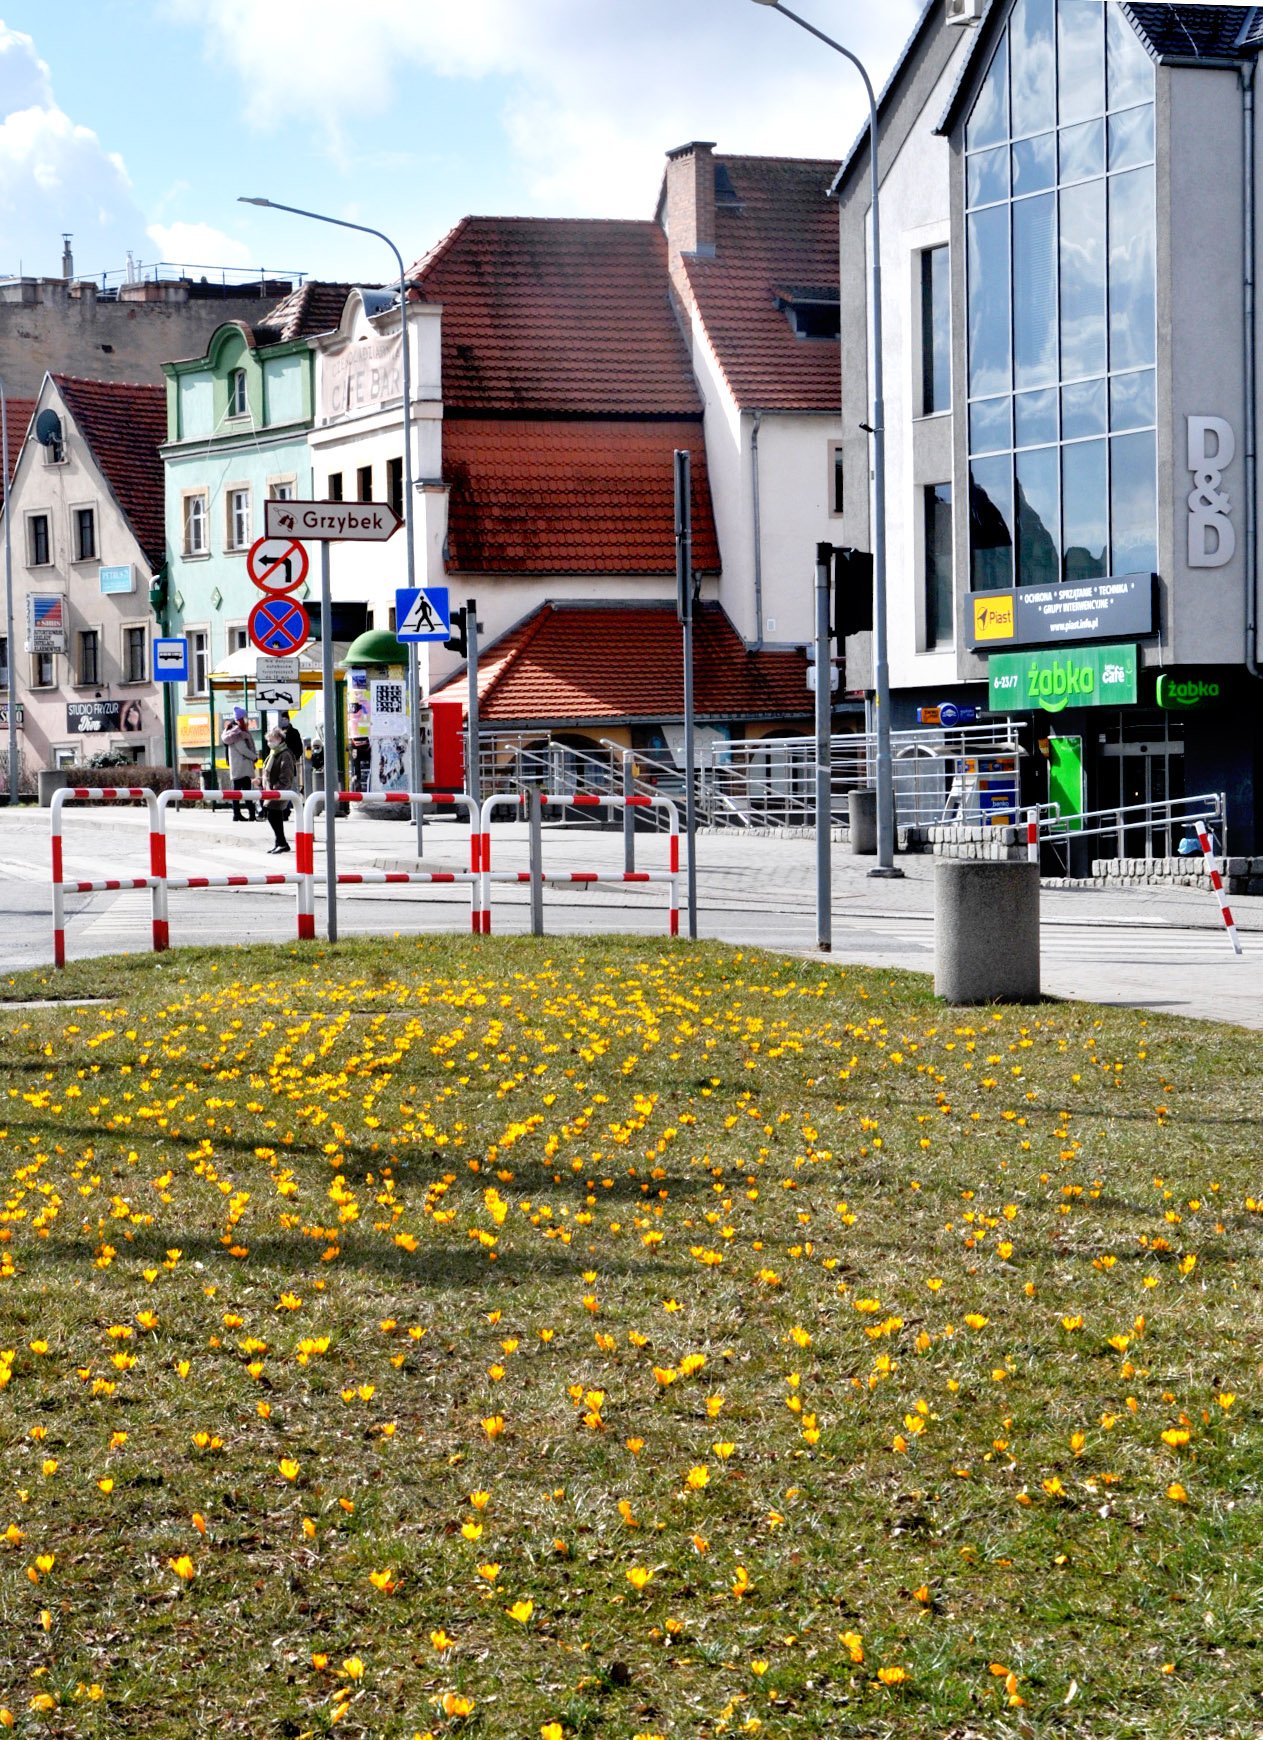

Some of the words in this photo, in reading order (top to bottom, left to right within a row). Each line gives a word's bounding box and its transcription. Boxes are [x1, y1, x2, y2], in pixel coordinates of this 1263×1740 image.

[371, 366, 400, 399] BAR
[302, 510, 383, 534] Grzybek
[1024, 591, 1053, 604] OCHRONA
[1099, 583, 1128, 595] TECHNIKA
[989, 611, 1012, 624] Piast
[1043, 603, 1062, 615] GRUPY
[993, 674, 1019, 689] 6-23/7
[1027, 660, 1094, 696] żabka
[1102, 666, 1125, 684] café
[1167, 680, 1220, 698] żabka
[68, 704, 93, 716] STUDIO
[94, 702, 119, 714] FRYZUR
